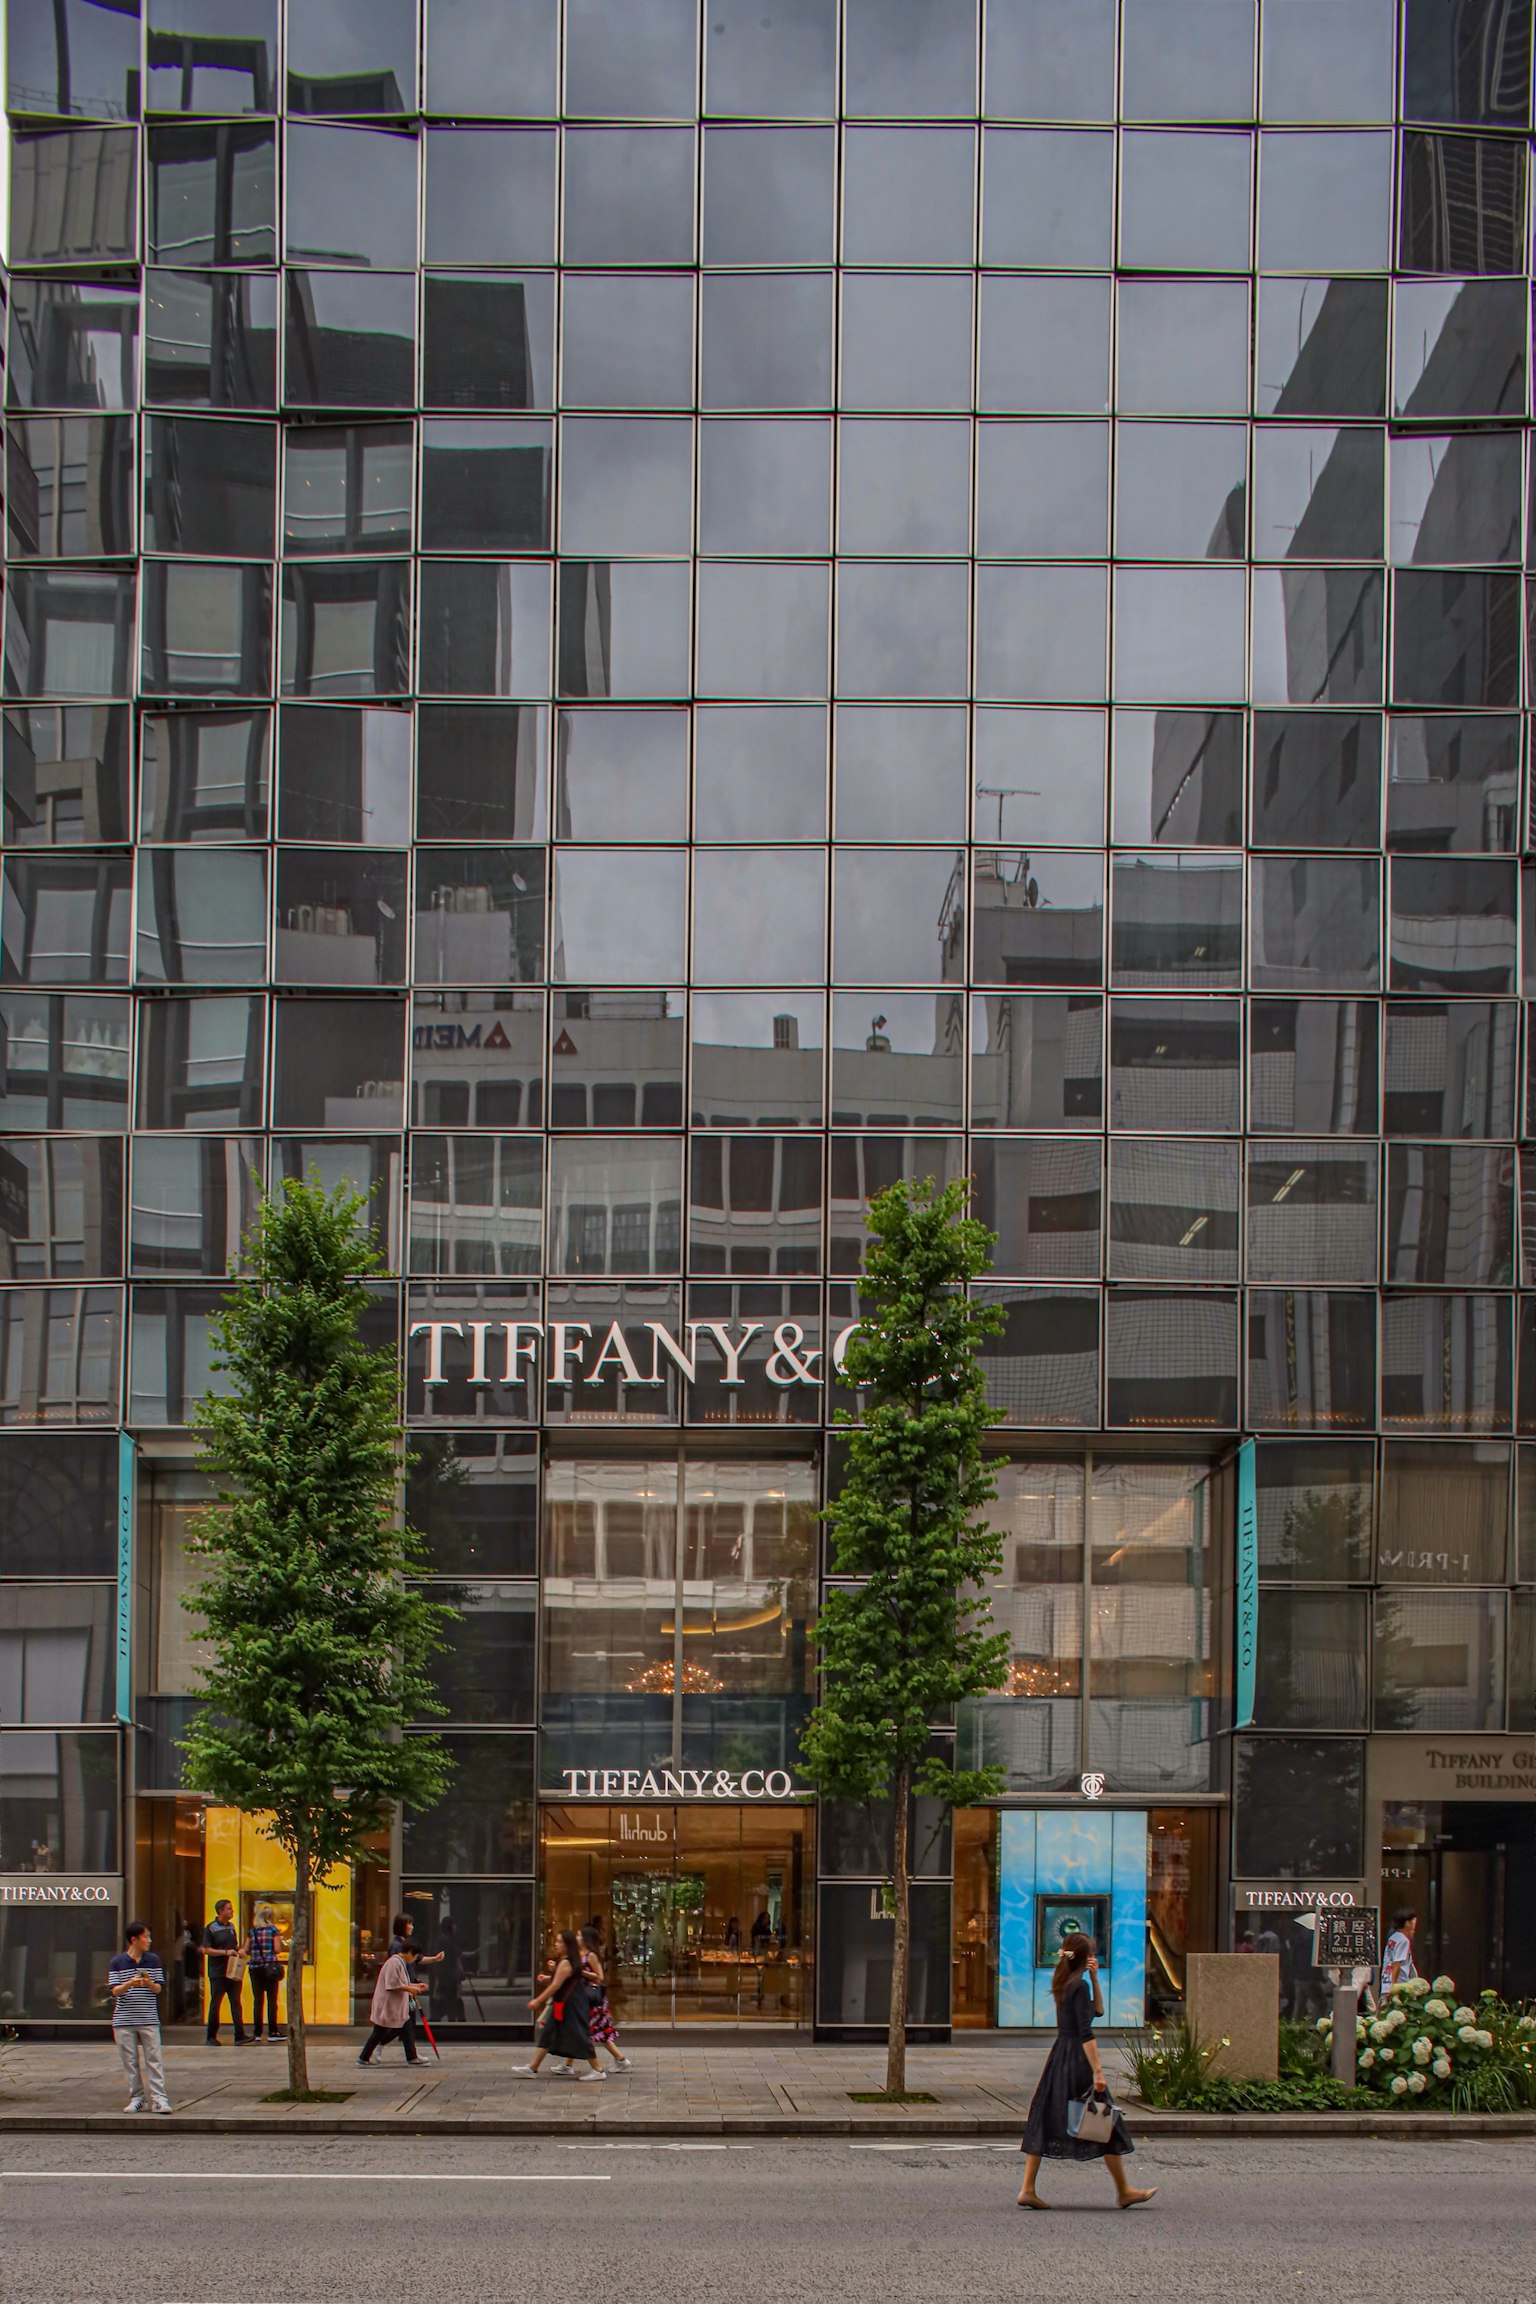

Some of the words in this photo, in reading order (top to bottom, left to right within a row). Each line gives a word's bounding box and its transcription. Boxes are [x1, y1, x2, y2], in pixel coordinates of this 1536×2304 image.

[1425, 1750, 1504, 1769] TIFFANY
[562, 1769, 796, 1798] TIFFANY&CO.
[1246, 1891, 1356, 1906] TIFFANY&CO.
[1333, 1920, 1365, 1934] 銀座
[1334, 1935, 1363, 1946] 2丁目
